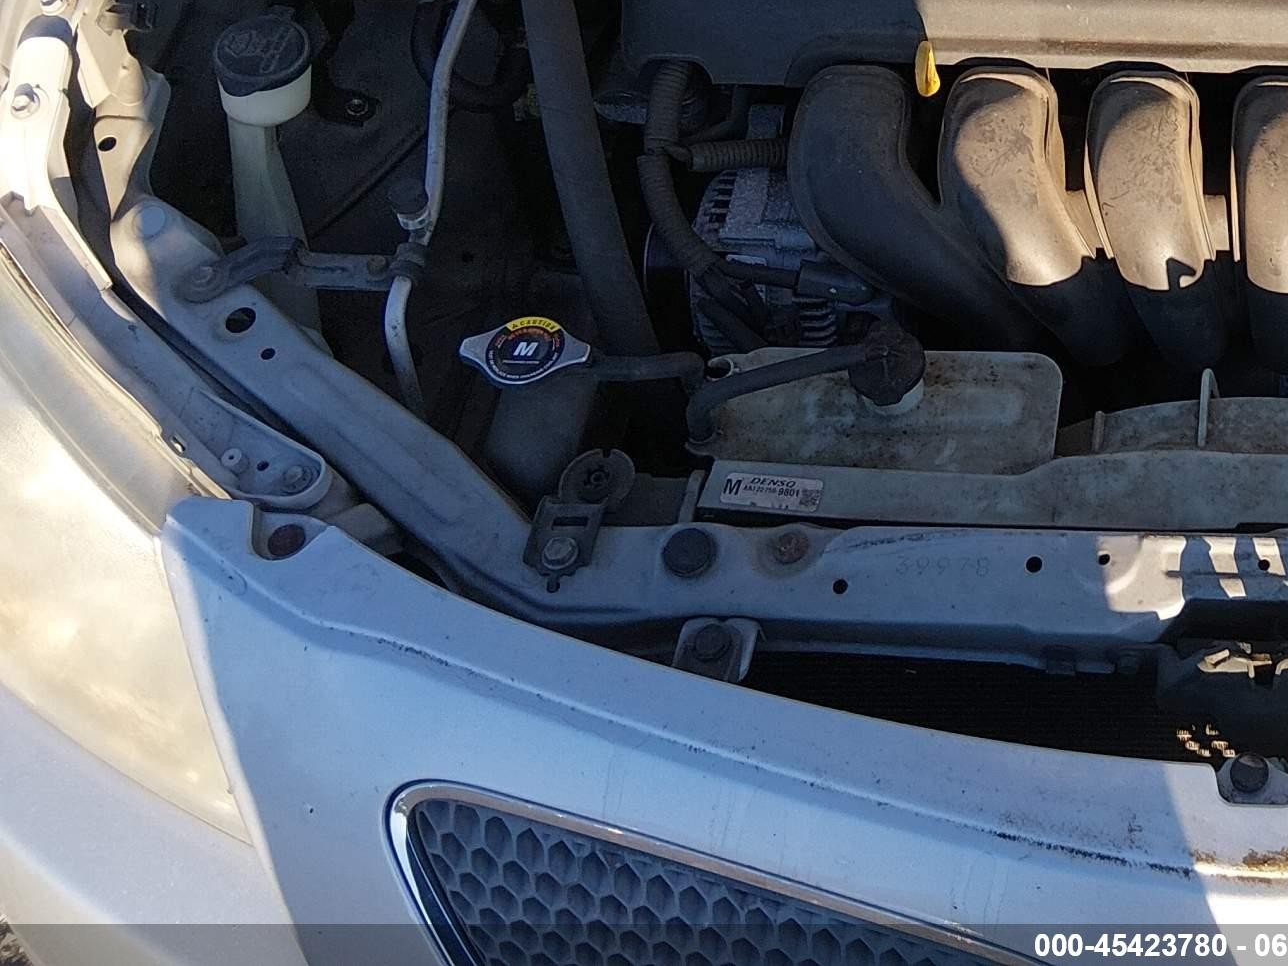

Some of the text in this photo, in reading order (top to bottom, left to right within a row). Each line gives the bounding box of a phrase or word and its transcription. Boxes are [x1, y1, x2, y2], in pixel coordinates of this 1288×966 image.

[513, 341, 539, 357] M
[723, 477, 797, 496] M DENSO
